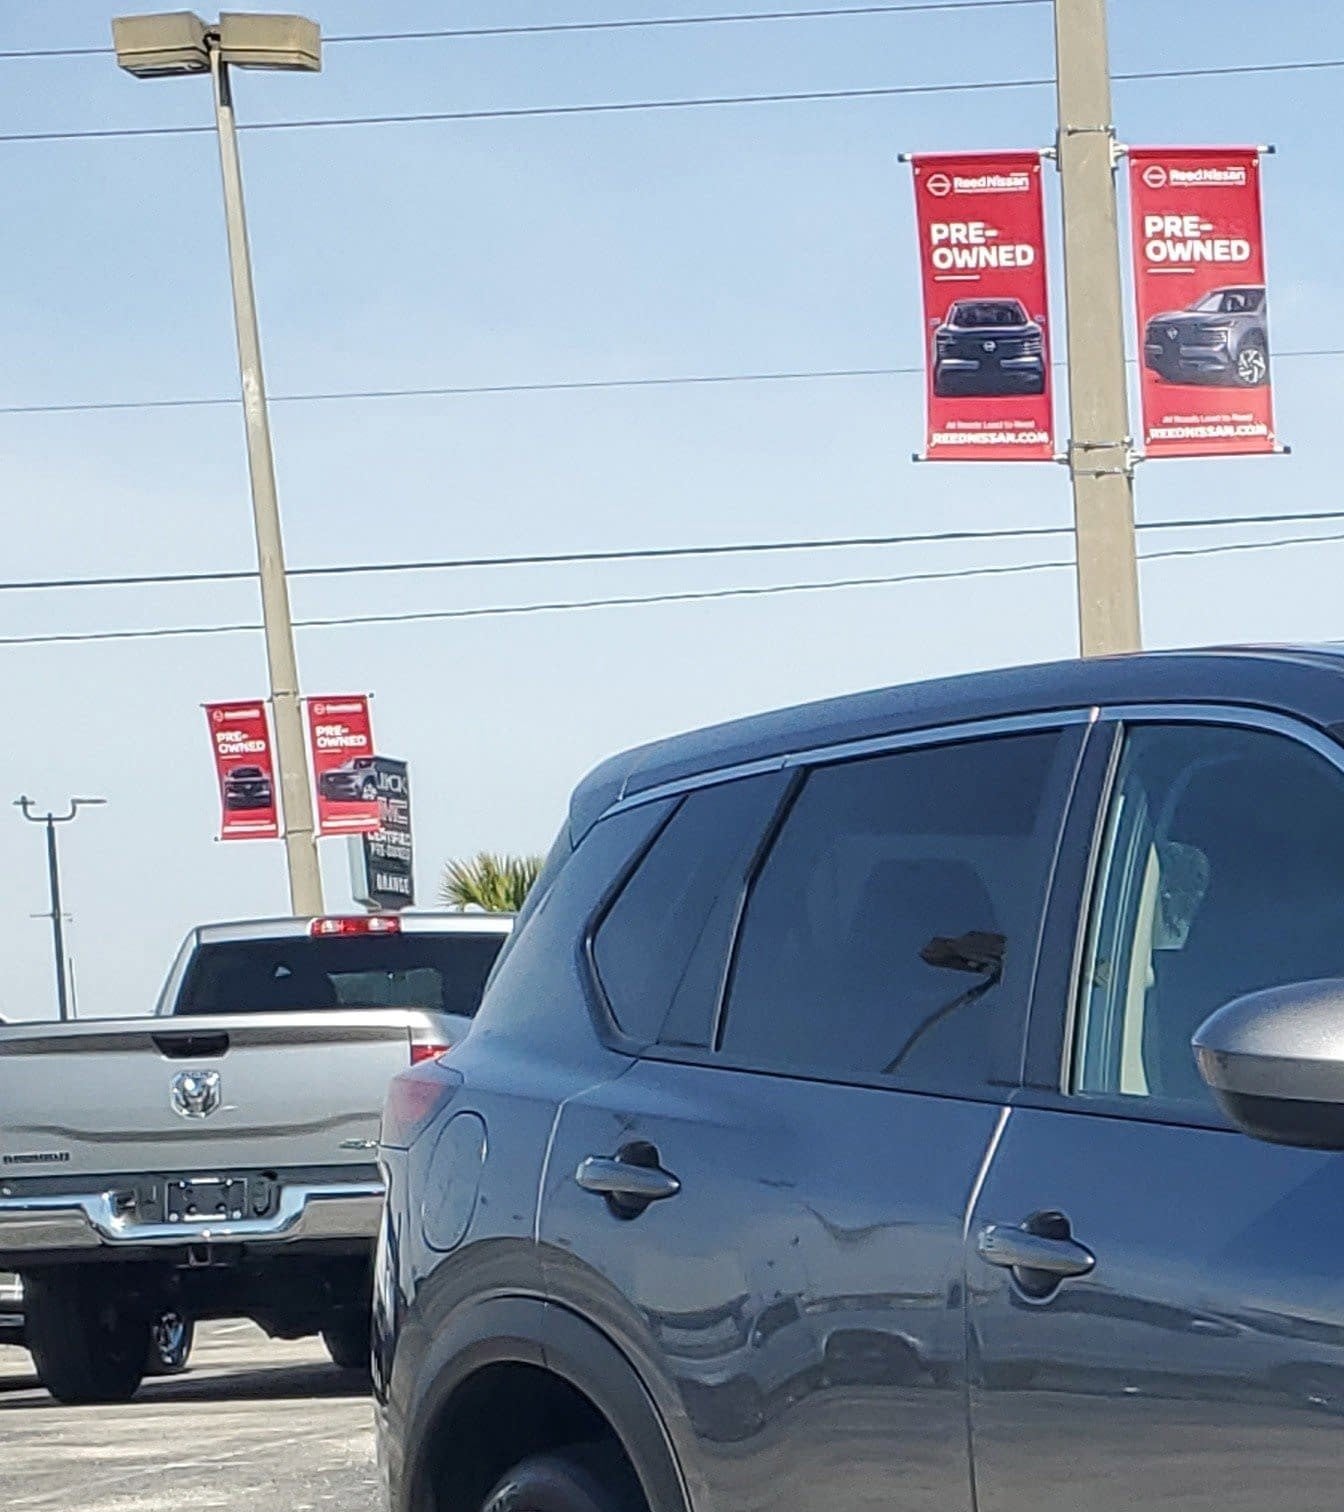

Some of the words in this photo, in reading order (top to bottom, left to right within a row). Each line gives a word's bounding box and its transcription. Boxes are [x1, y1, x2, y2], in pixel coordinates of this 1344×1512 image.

[930, 221, 999, 246] PRE-
[1144, 215, 1214, 239] PRE-
[932, 243, 1035, 270] OWNED
[1145, 239, 1251, 263] OWNED
[216, 731, 249, 743] PRE-
[316, 725, 349, 737] PRE-
[218, 739, 266, 754] OWNED
[317, 734, 367, 748] OWNED
